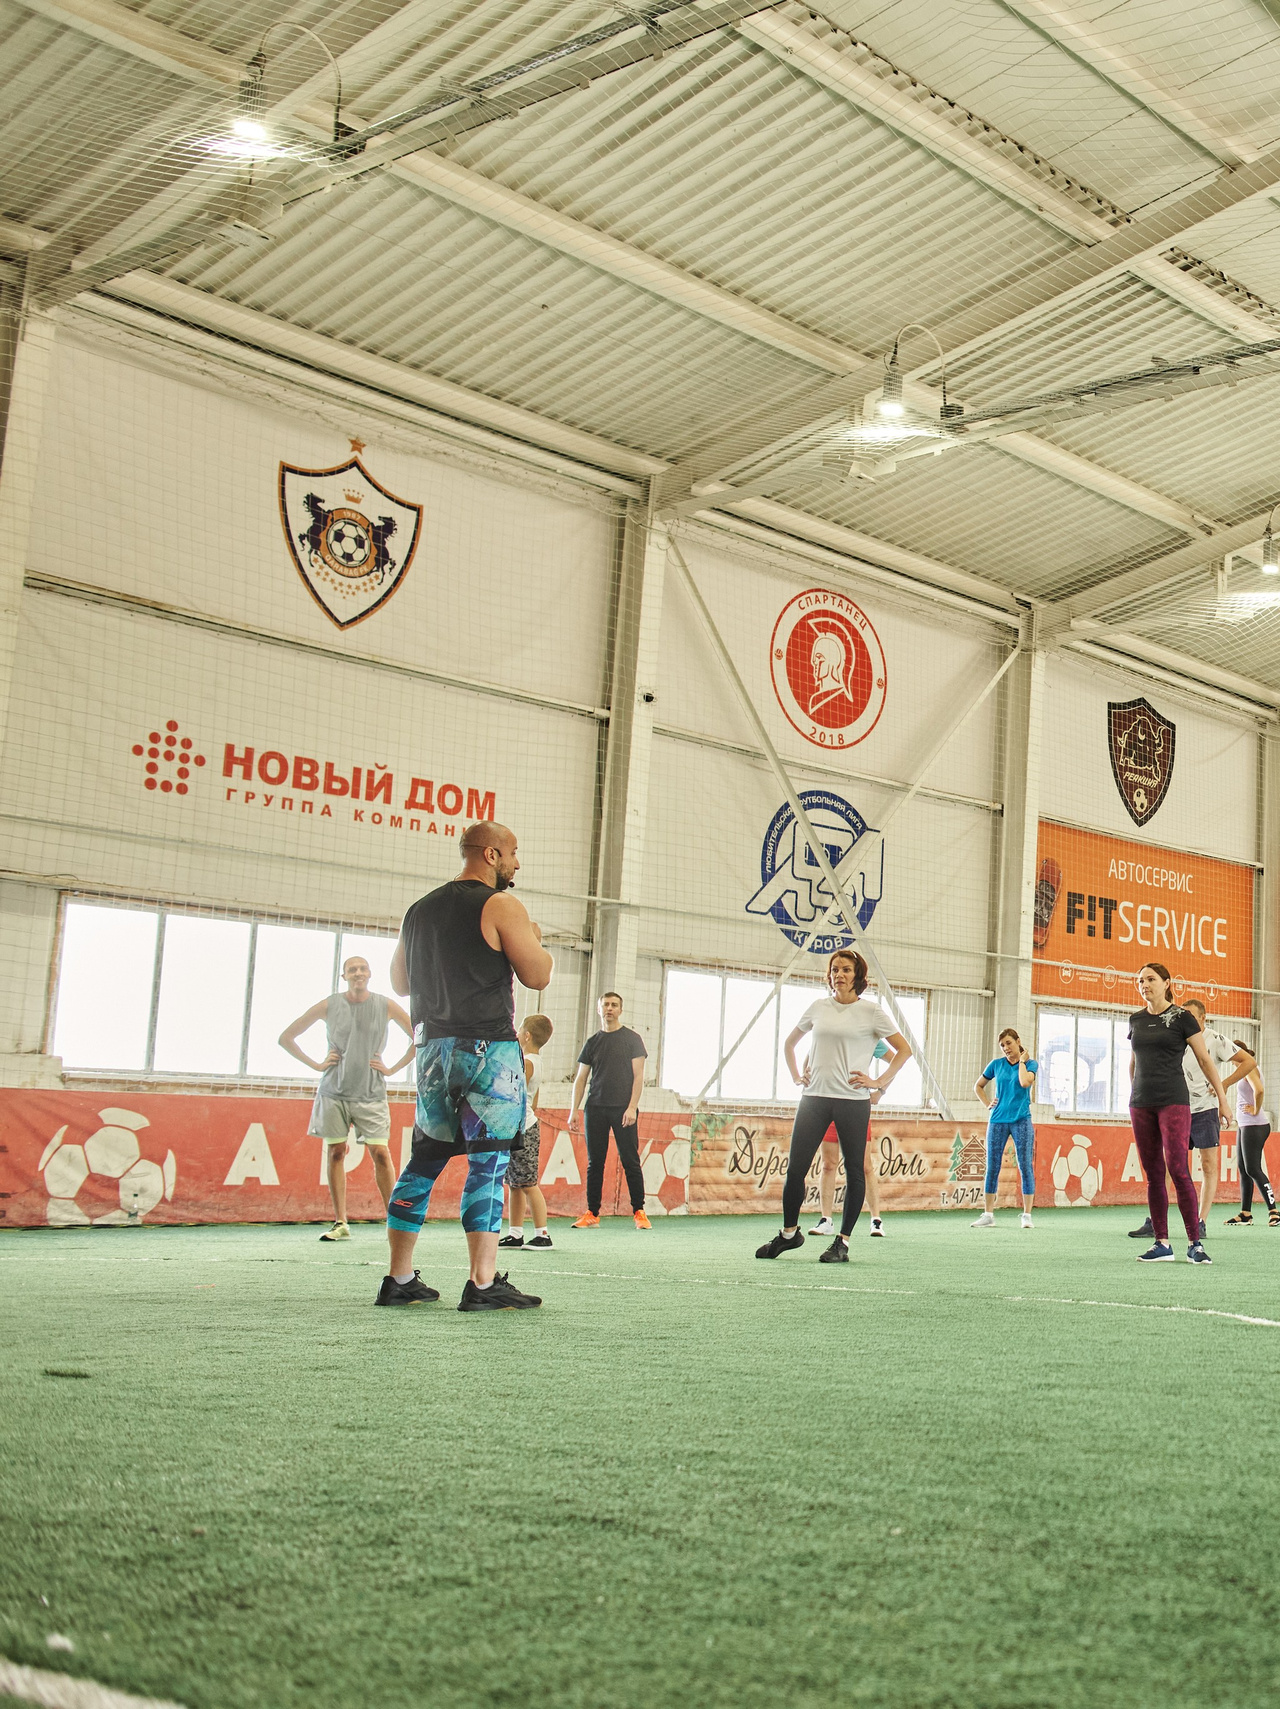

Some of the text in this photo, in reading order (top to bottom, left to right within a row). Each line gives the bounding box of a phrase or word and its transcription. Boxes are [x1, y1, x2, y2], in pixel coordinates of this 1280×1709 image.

[798, 594, 867, 631] СПАРТАНЕЦ
[809, 726, 845, 745] 2018
[222, 743, 496, 822] НОВЫЙ ДОМ
[1123, 771, 1158, 788] РЕАКЦИЯ
[226, 788, 466, 838] ГРУППА КОМПАН
[846, 810, 863, 829] ЛИГА
[1108, 858, 1194, 894] АВТОСЕРВИС
[794, 929, 844, 951] КРОВ
[952, 1187, 997, 1204] 47-17-
[1263, 1183, 1275, 1205] FILA
